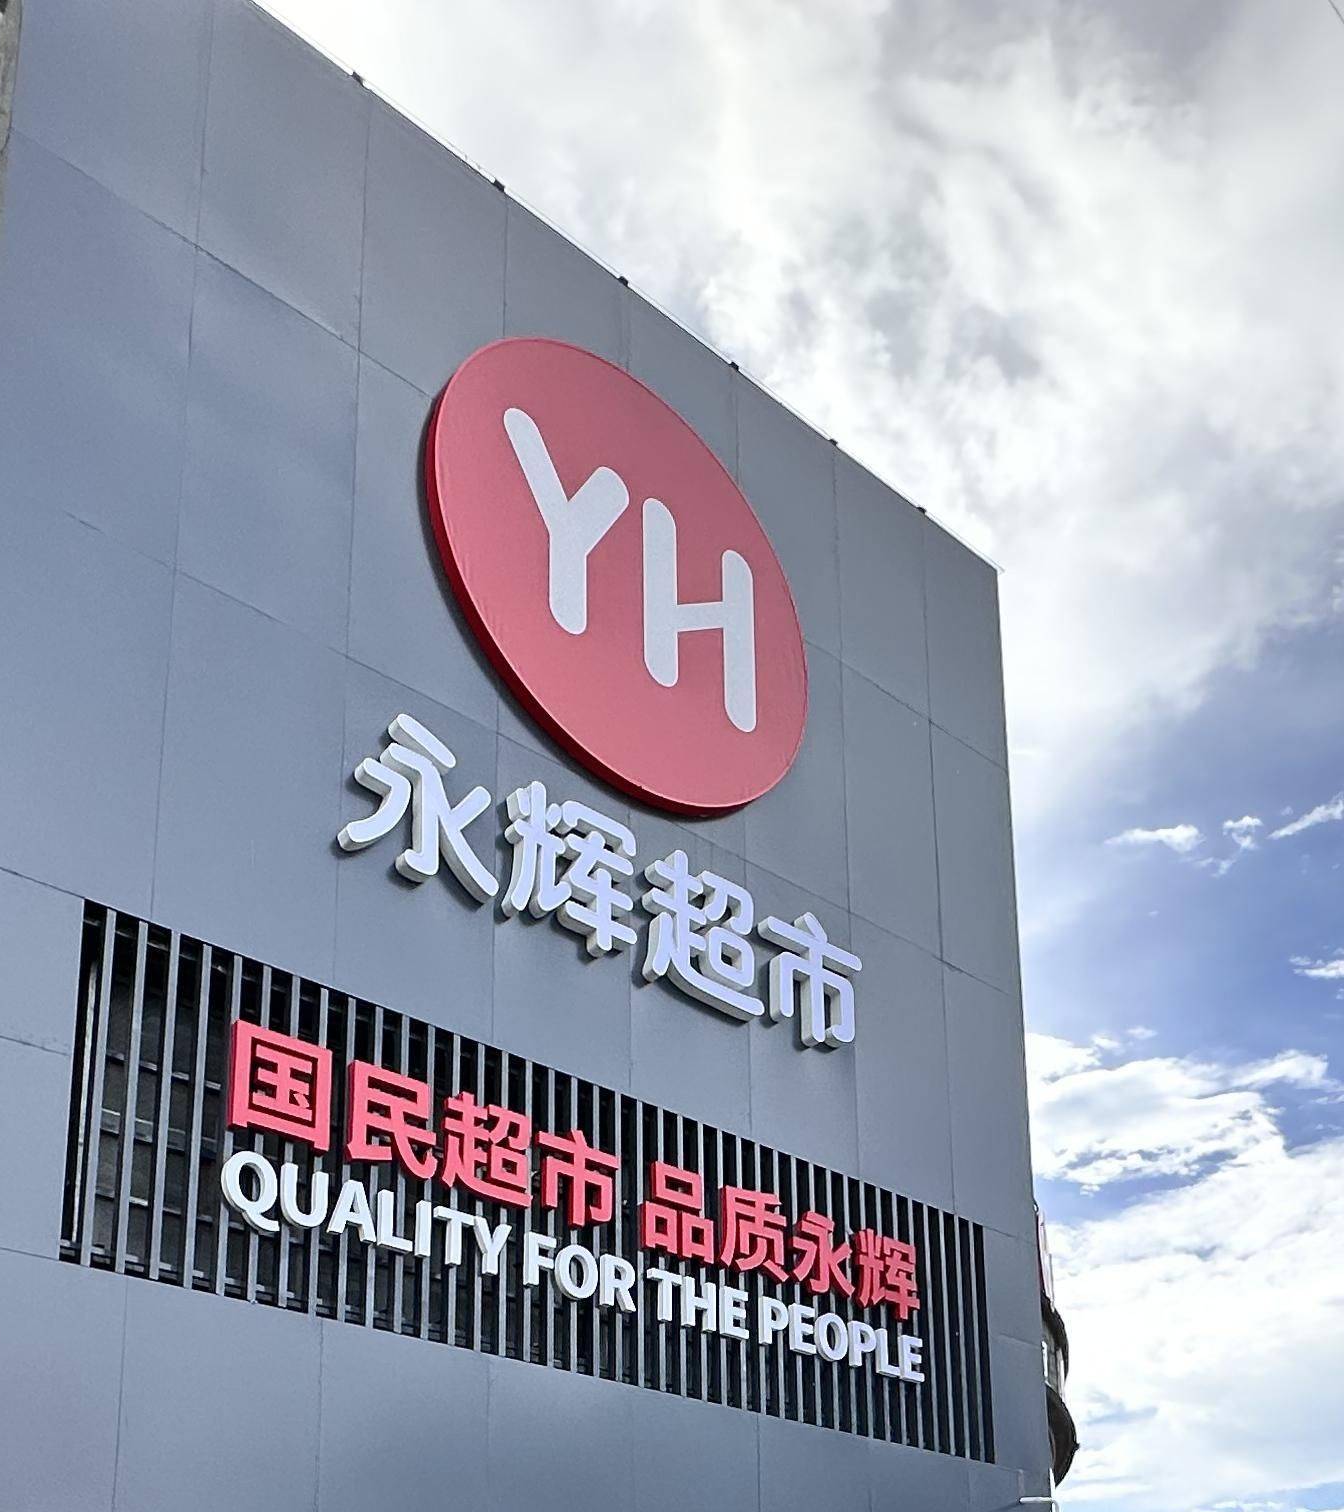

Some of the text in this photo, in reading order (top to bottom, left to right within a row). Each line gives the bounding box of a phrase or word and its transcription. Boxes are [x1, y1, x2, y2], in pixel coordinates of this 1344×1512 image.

[503, 406, 757, 733] YH
[338, 712, 863, 1048] 永辉超市
[221, 1150, 926, 1384] QUALITY FOR THE PEOPLE
[227, 1019, 921, 1321] 国民超市 品质永辉
